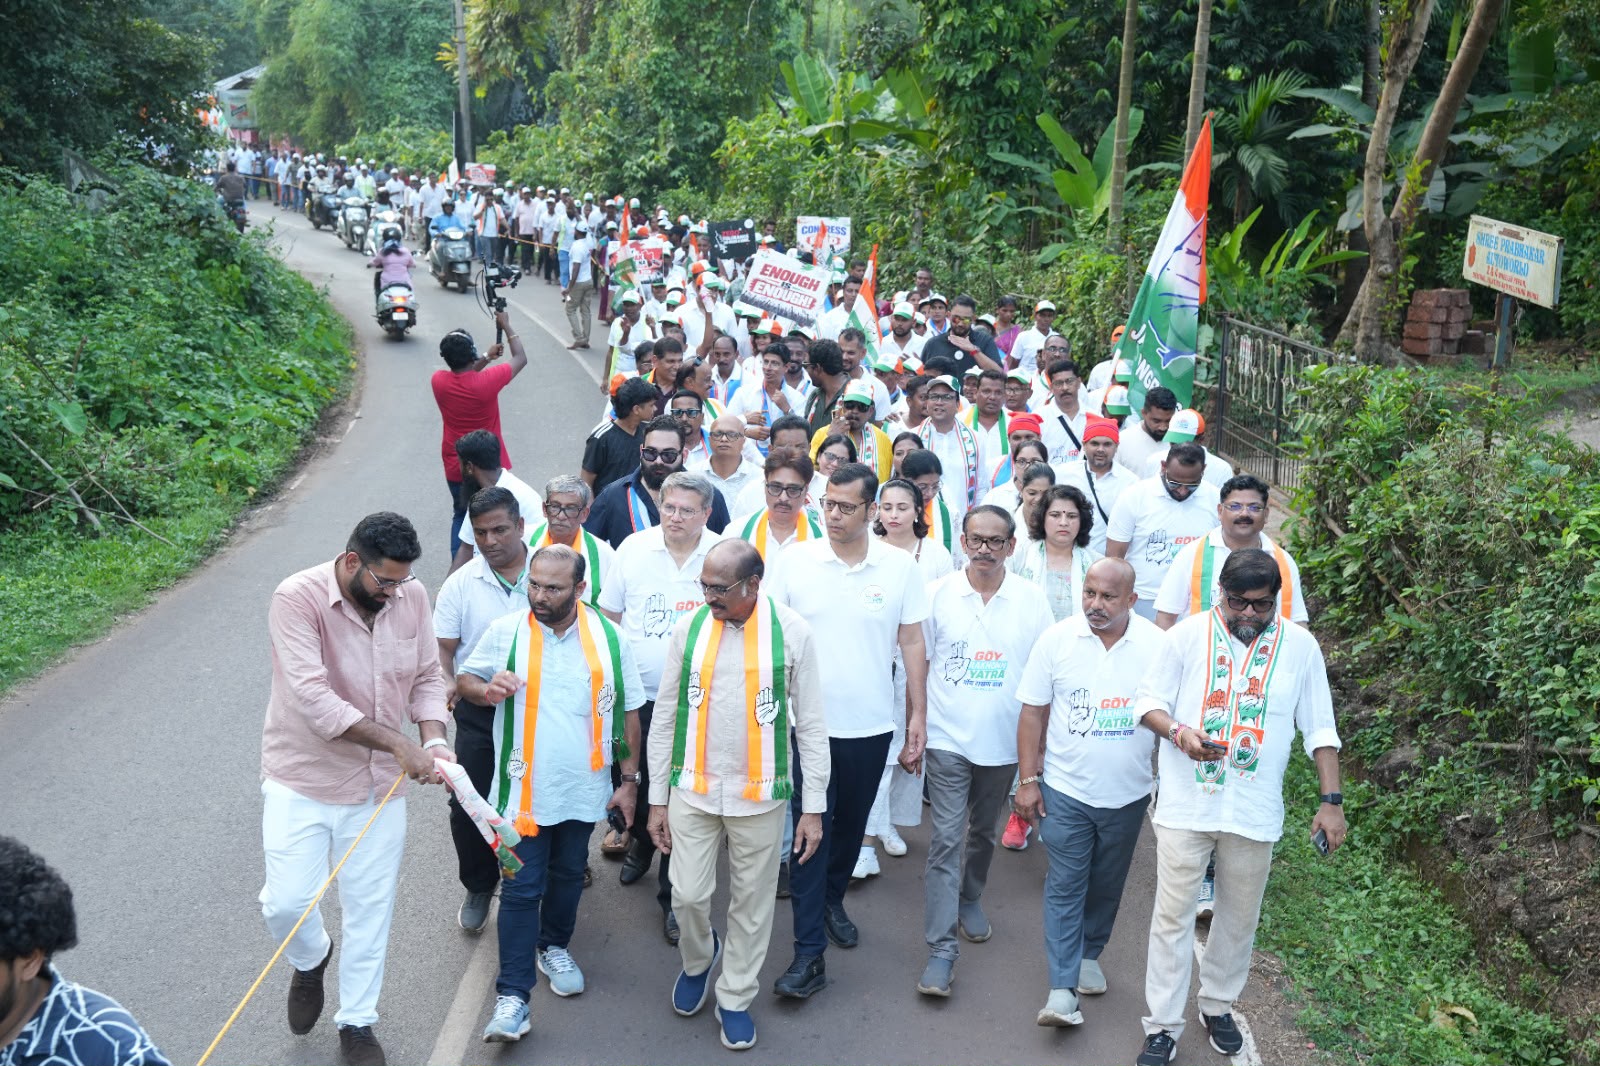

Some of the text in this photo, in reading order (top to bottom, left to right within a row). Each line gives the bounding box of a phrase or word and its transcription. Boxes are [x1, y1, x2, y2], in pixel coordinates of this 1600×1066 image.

[1476, 232, 1499, 250] SHREE
[1500, 238, 1545, 265] PRABHAKAR
[760, 264, 820, 291] ENOUGH
[754, 281, 812, 308] ENOUGH!
[969, 670, 1005, 679] YATRA
[1097, 717, 1134, 729] YATRA
